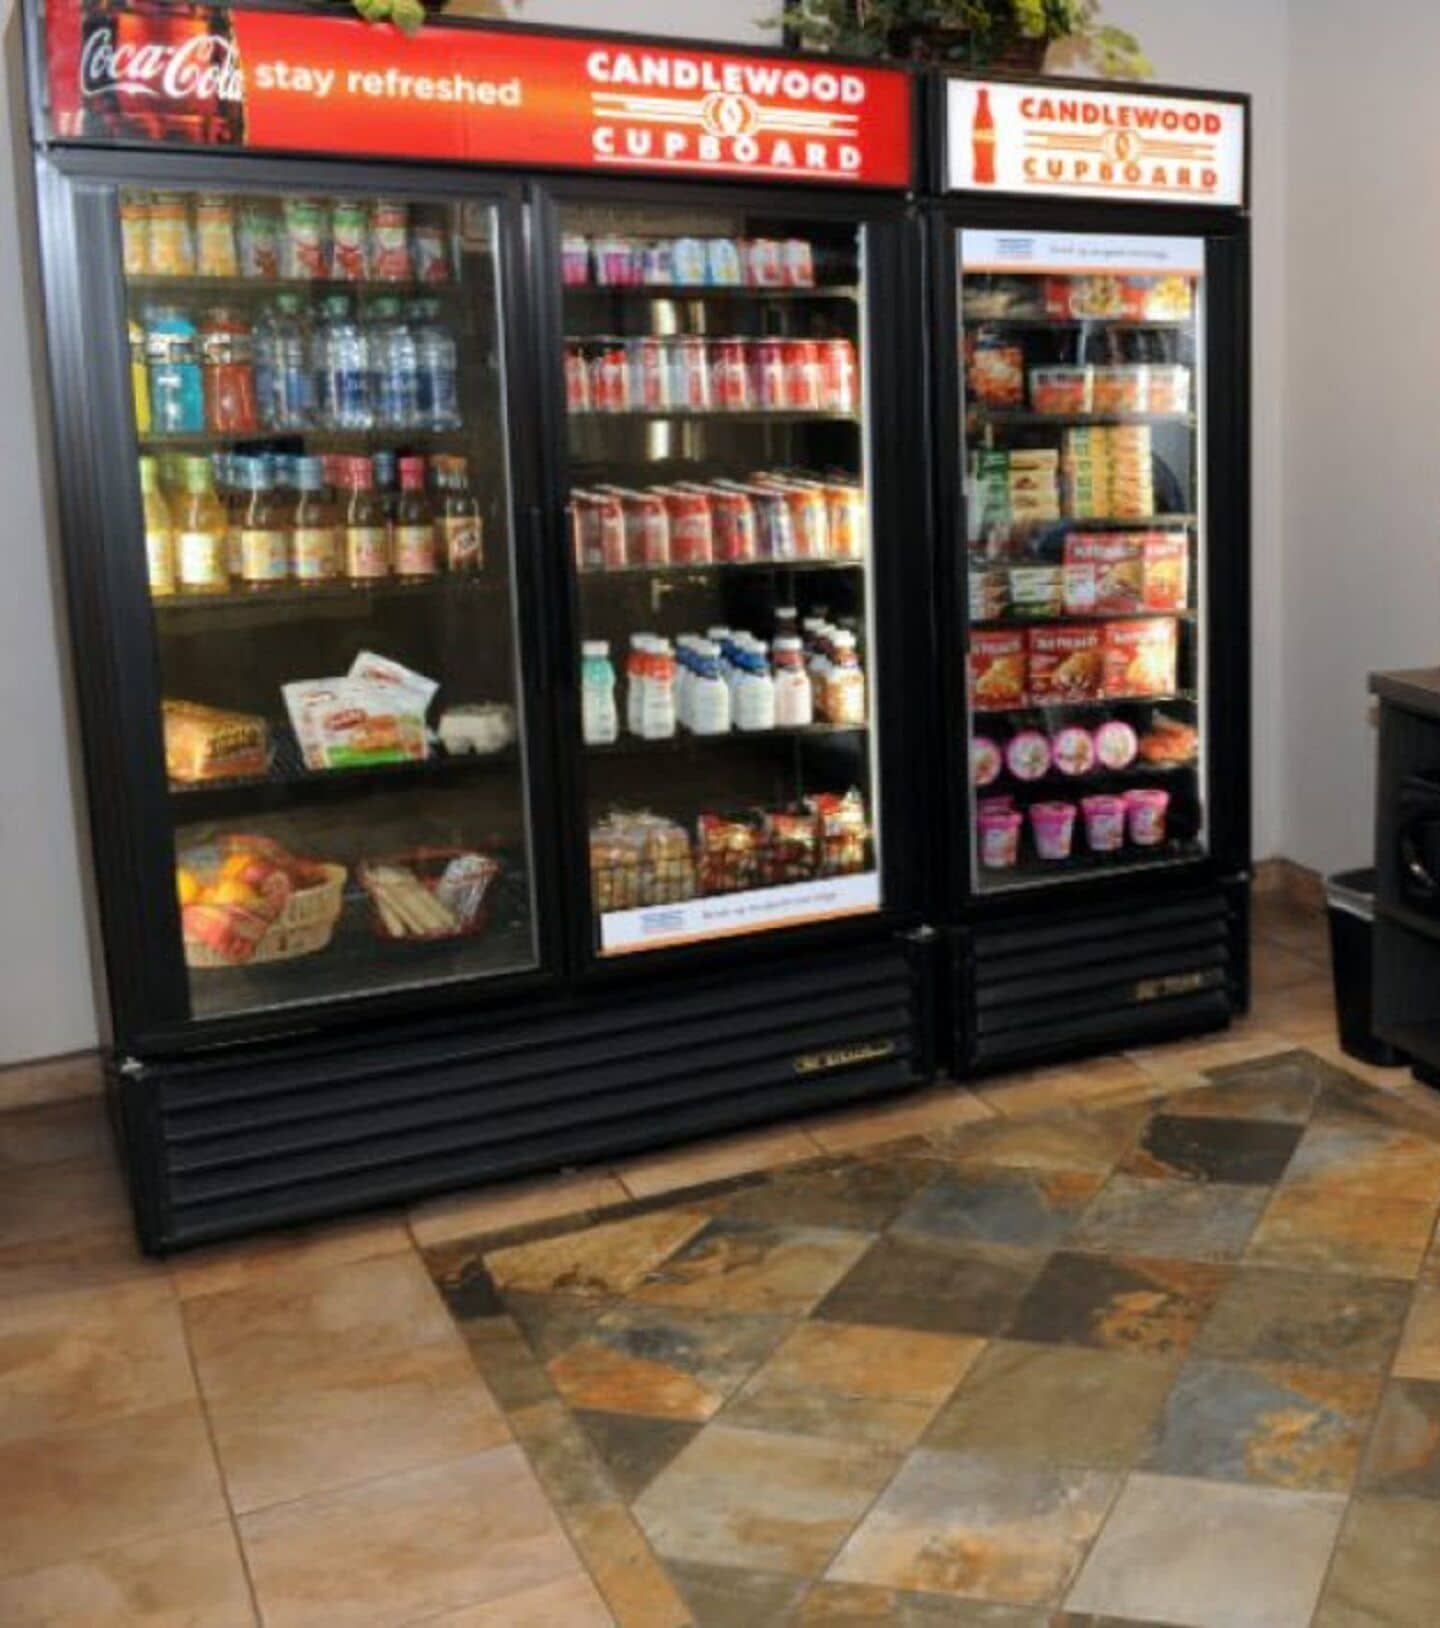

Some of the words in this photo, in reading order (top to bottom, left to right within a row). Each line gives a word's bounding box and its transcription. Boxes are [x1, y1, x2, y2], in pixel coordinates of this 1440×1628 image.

[80, 28, 245, 101] Coca-Cola
[255, 60, 334, 97] stay
[347, 68, 522, 107] refreshed
[587, 51, 866, 103] CANDLEWOOD
[1018, 97, 1222, 134] CANDLEWOOD
[592, 127, 862, 170] CUPBOARD
[1022, 157, 1219, 189] CUPBOARD
